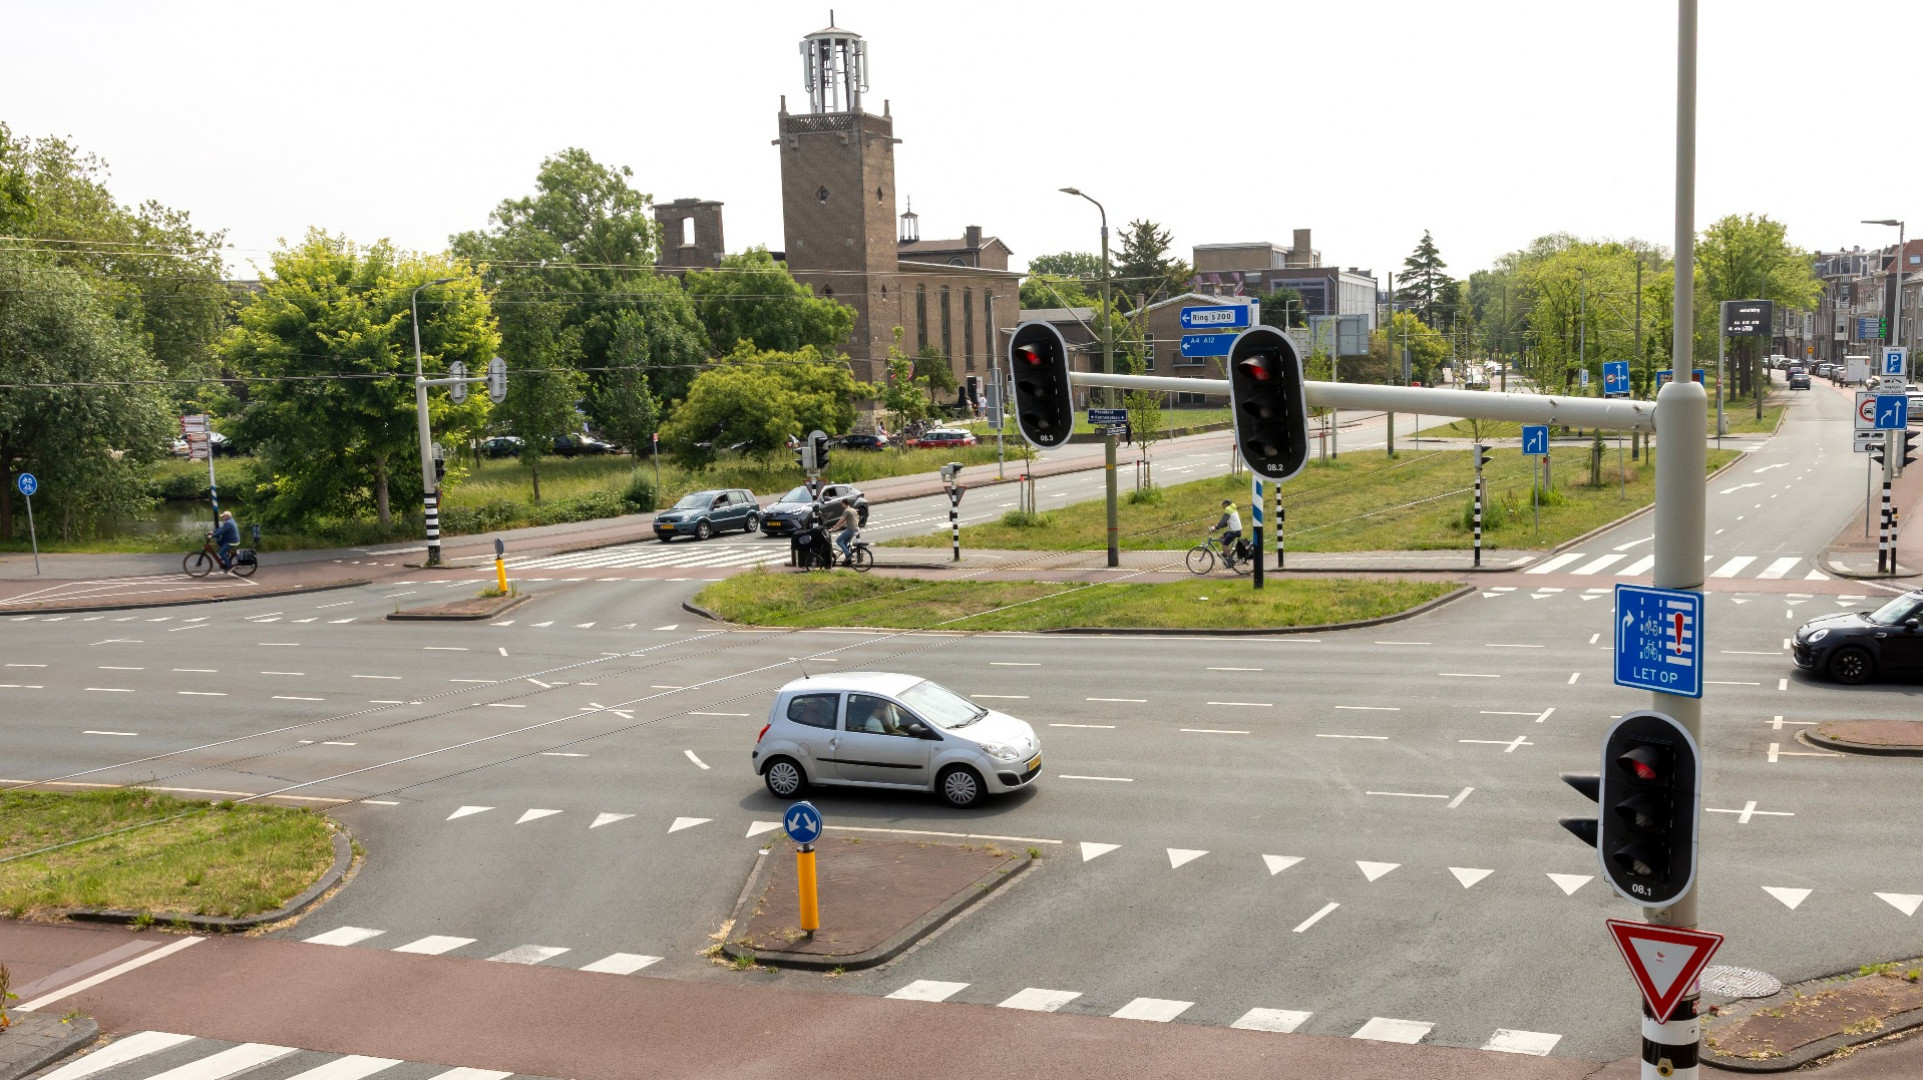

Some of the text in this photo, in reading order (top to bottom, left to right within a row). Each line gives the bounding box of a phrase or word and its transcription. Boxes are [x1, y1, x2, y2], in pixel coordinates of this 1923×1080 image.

[1192, 314, 1209, 322] Ring
[1203, 336, 1215, 344] A12
[1267, 463, 1284, 471] 08.2
[1633, 666, 1678, 683] LET OP
[1631, 883, 1652, 896] 08.1
